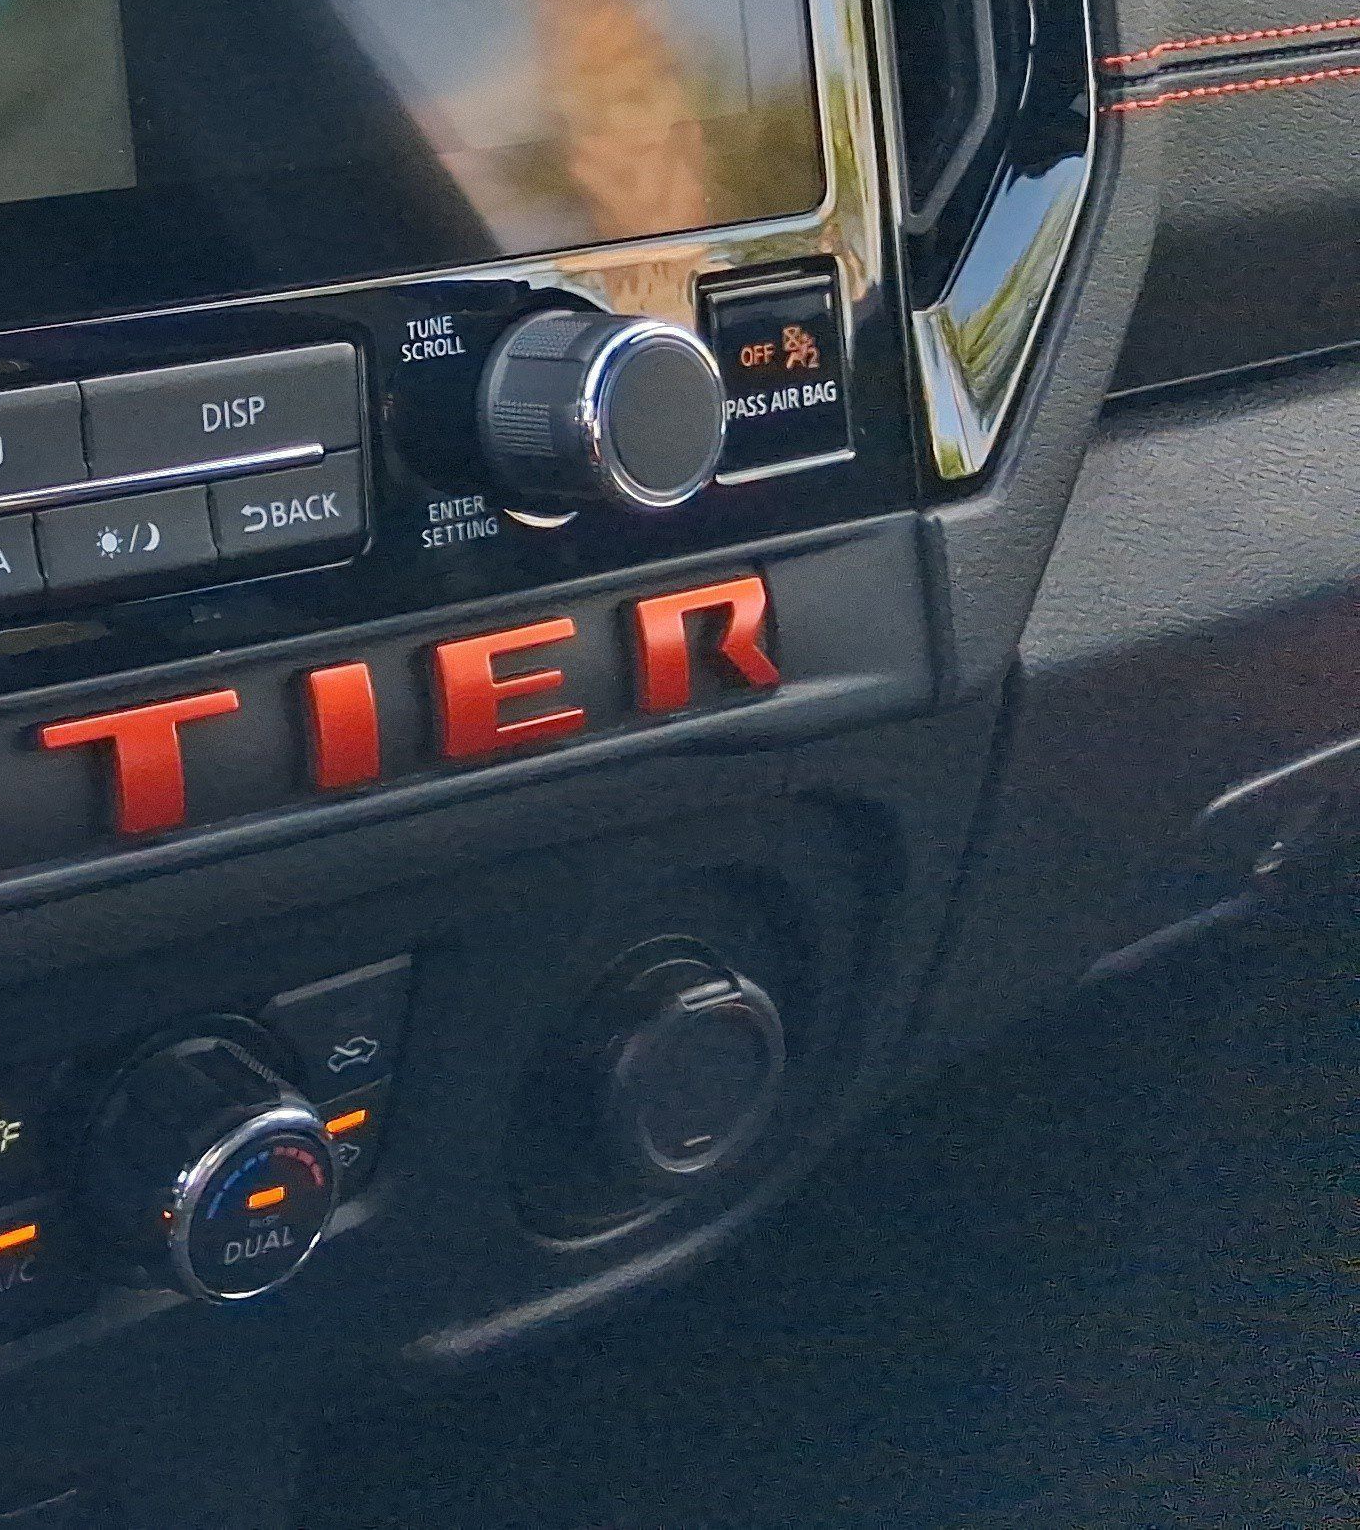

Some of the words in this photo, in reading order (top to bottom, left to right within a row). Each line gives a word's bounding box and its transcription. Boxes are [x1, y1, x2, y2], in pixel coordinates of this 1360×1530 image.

[406, 316, 454, 341] TUNE
[401, 334, 467, 362] SCROLL
[740, 342, 775, 367] OFF
[200, 395, 267, 434] DISP
[726, 393, 767, 420] PASS
[770, 388, 801, 412] AIR
[802, 380, 837, 407] BAG
[270, 489, 340, 529] BACK
[428, 495, 486, 522] ENTER
[420, 517, 499, 549] SETTING
[224, 1225, 294, 1266] DUAL
